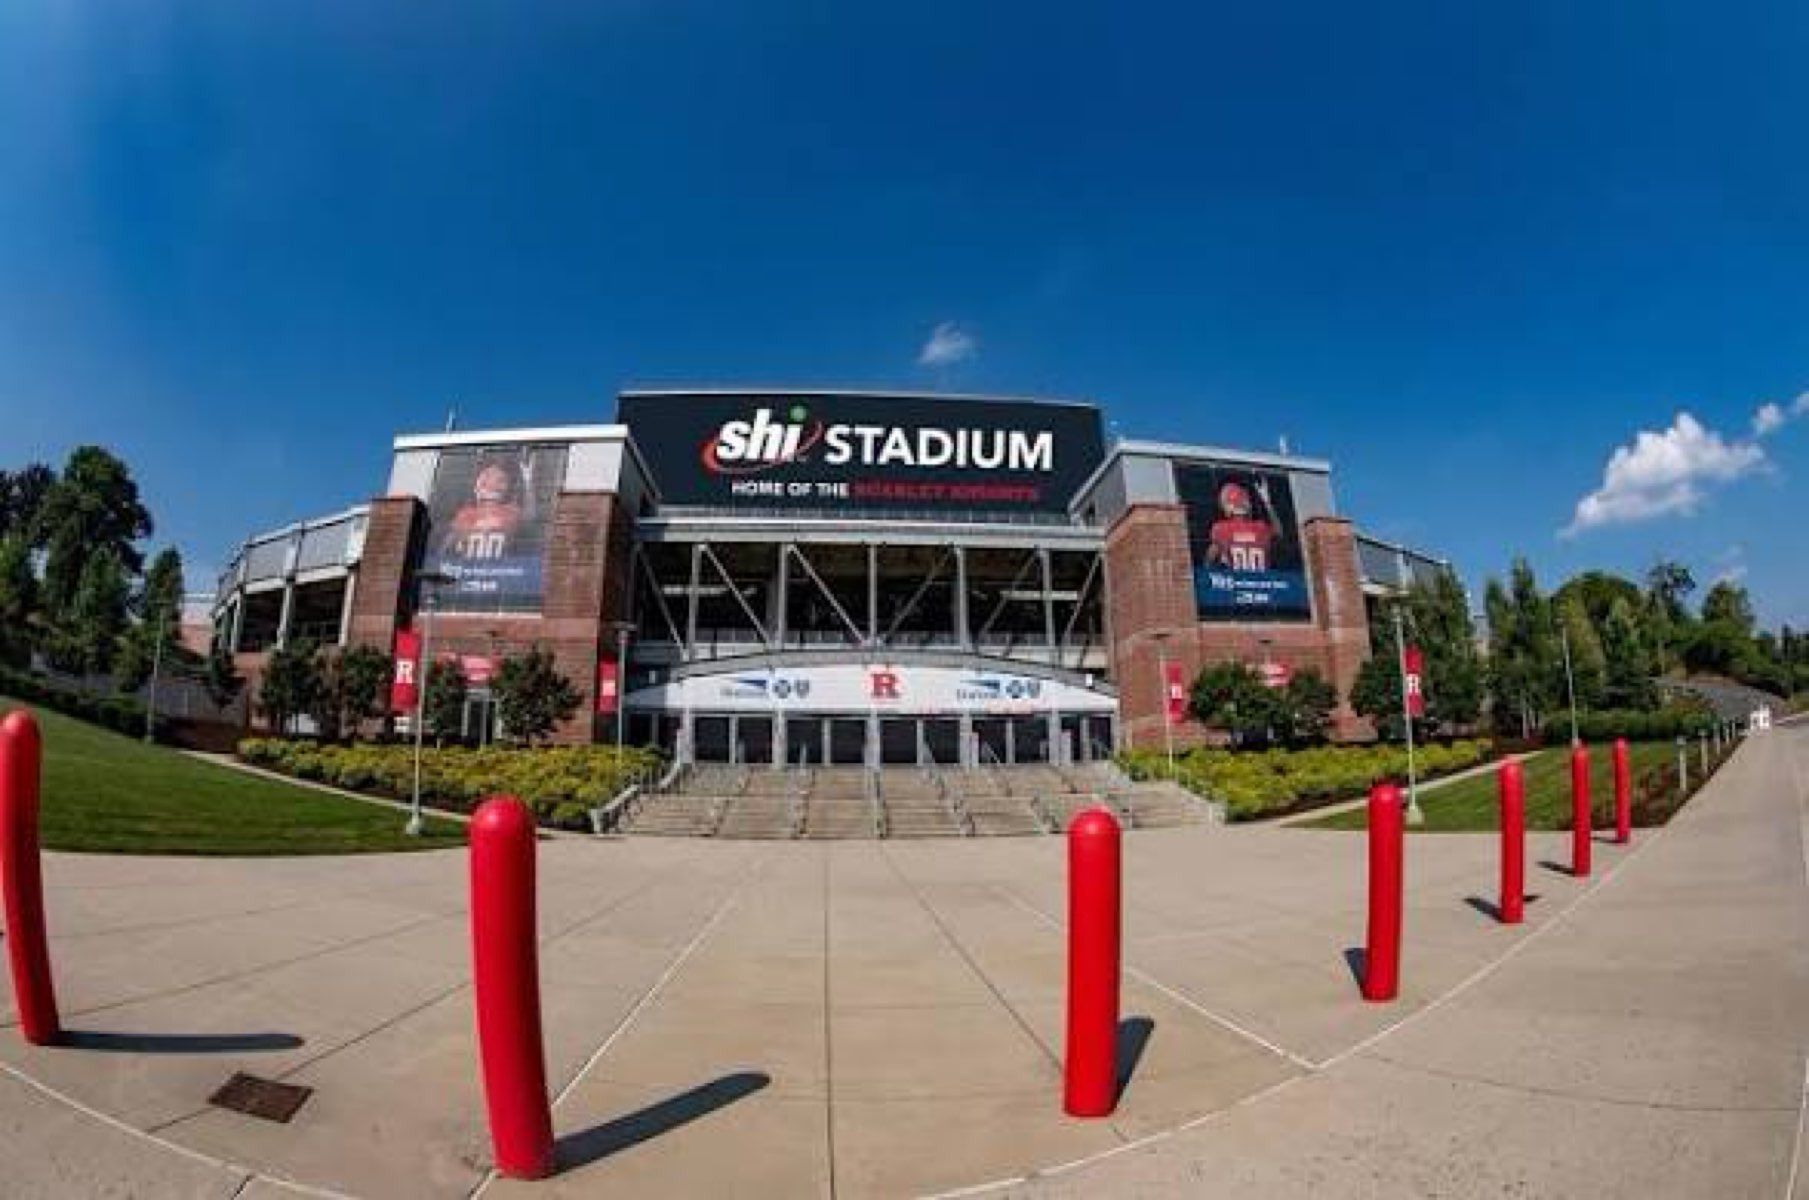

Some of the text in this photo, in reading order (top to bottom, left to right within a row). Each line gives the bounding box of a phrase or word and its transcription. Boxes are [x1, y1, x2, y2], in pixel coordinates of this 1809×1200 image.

[717, 406, 1053, 470] shi STADIUM
[732, 481, 784, 496] HOME
[787, 482, 811, 496] OF
[815, 482, 849, 497] THE
[872, 673, 900, 698] R
